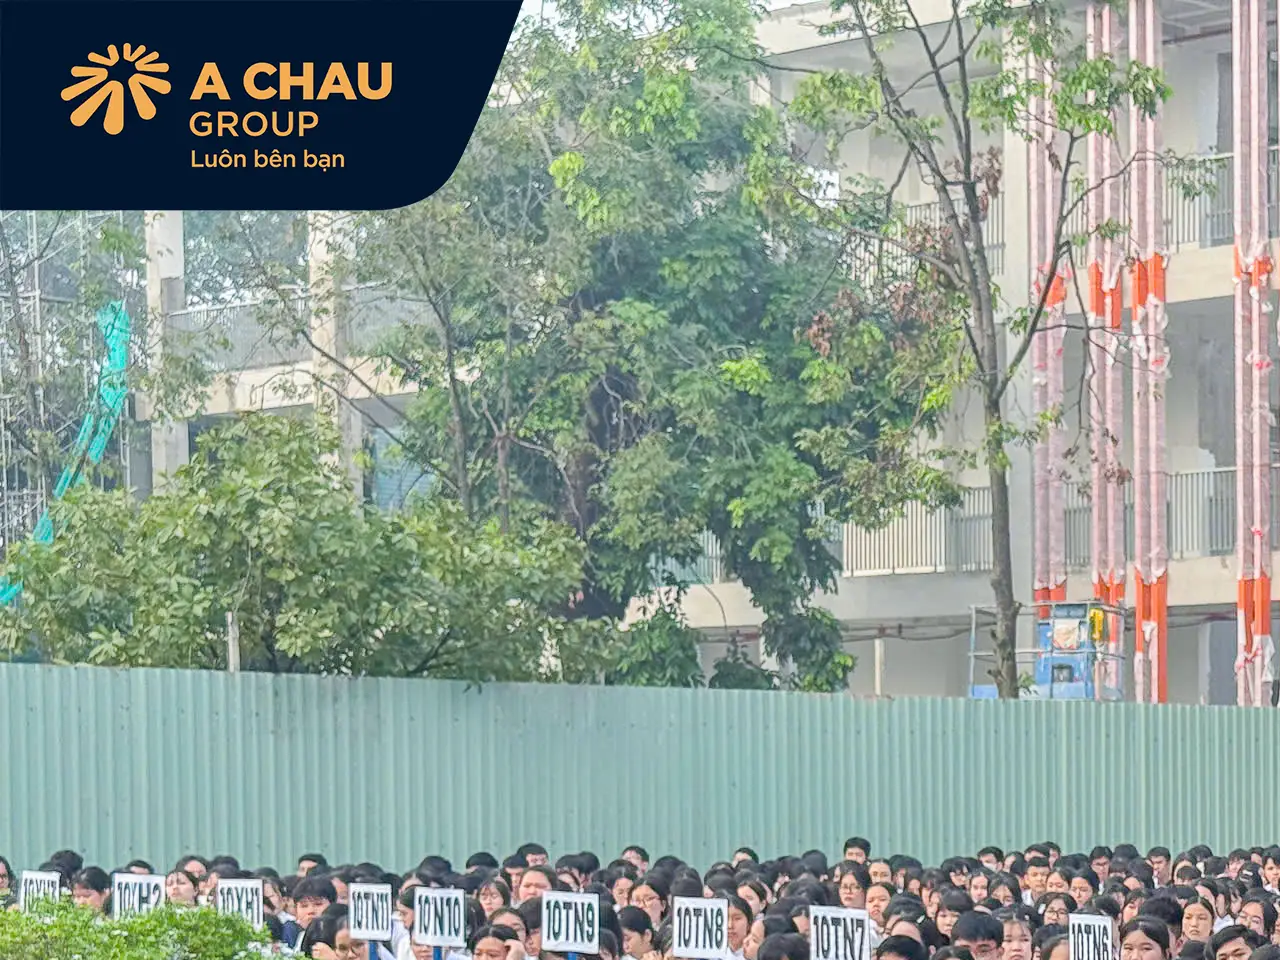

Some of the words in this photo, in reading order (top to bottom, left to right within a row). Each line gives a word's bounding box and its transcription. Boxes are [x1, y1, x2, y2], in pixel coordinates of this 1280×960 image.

[352, 890, 389, 932] 10TN11
[418, 894, 461, 937] 10N10
[546, 900, 594, 942] 10TN9
[677, 907, 723, 949] 10TN8
